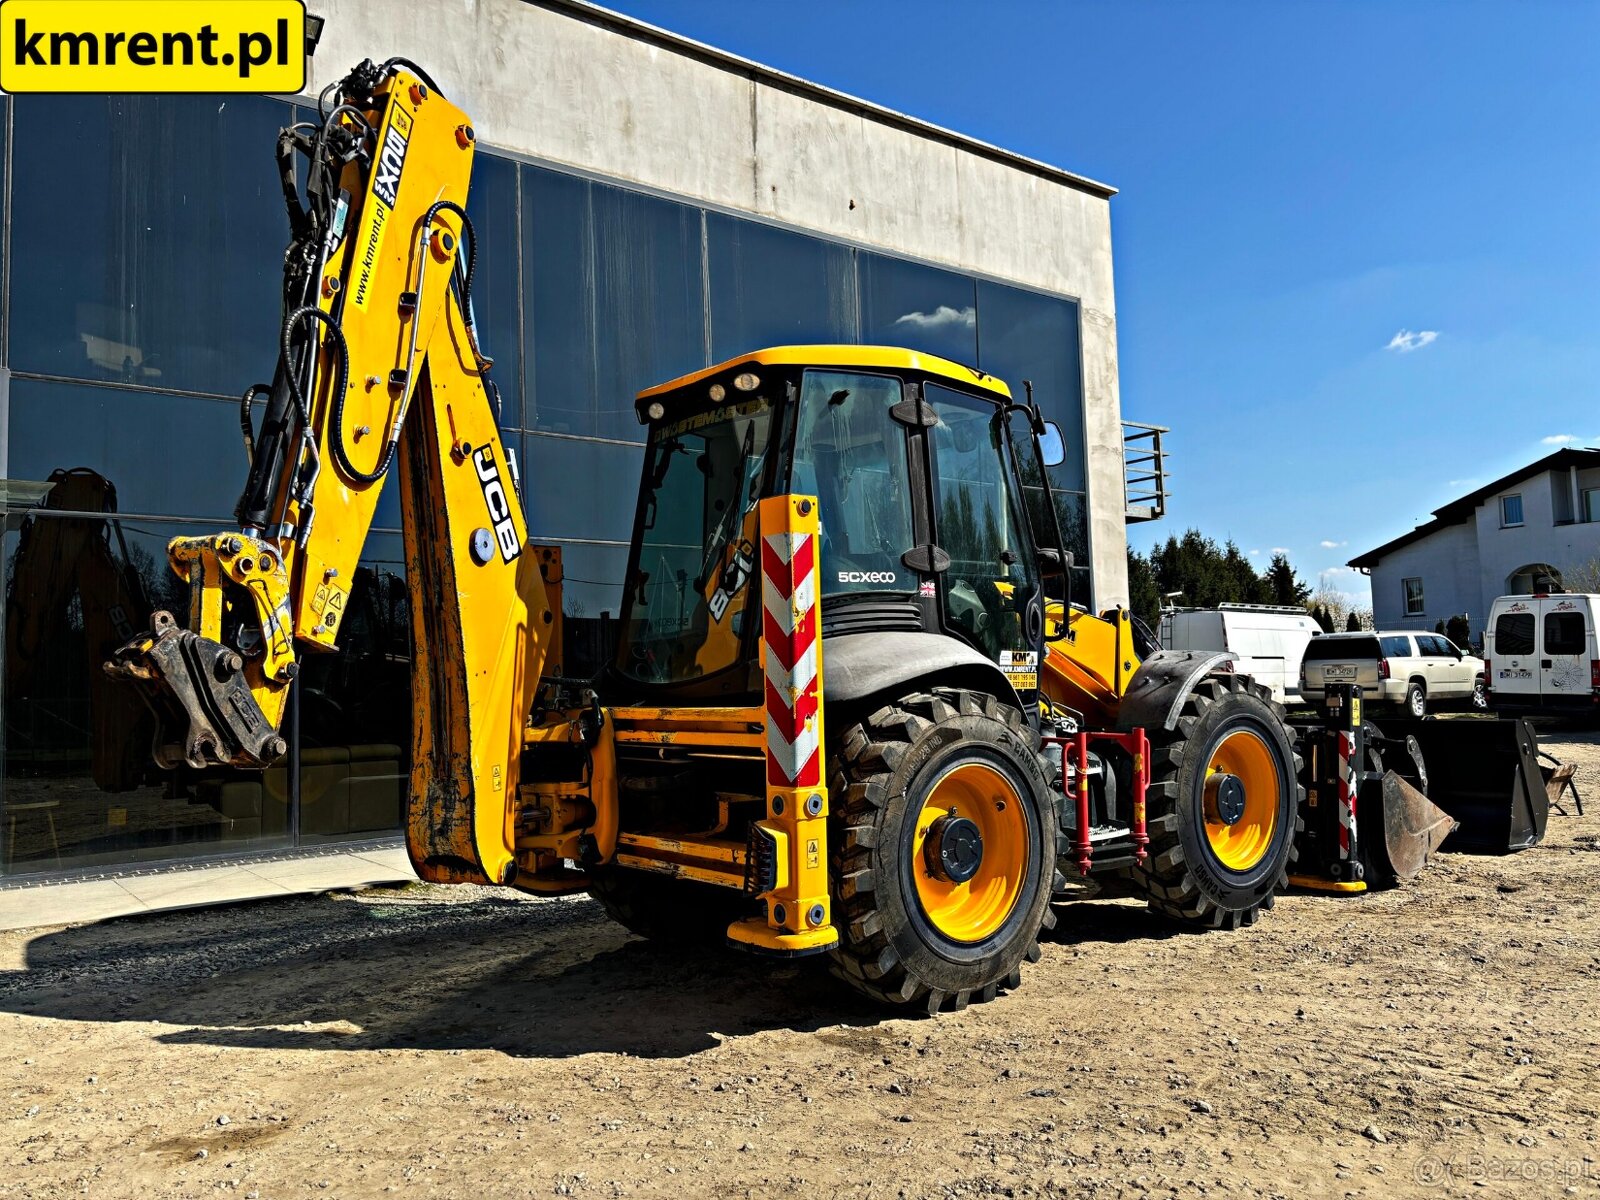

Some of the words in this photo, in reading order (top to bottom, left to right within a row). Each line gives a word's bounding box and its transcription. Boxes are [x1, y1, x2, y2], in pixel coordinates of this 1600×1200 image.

[376, 126, 407, 197] 5CX
[355, 202, 385, 305] www.kmrent.pl
[474, 450, 519, 561] JCB
[838, 571, 896, 583] 5CXeco
